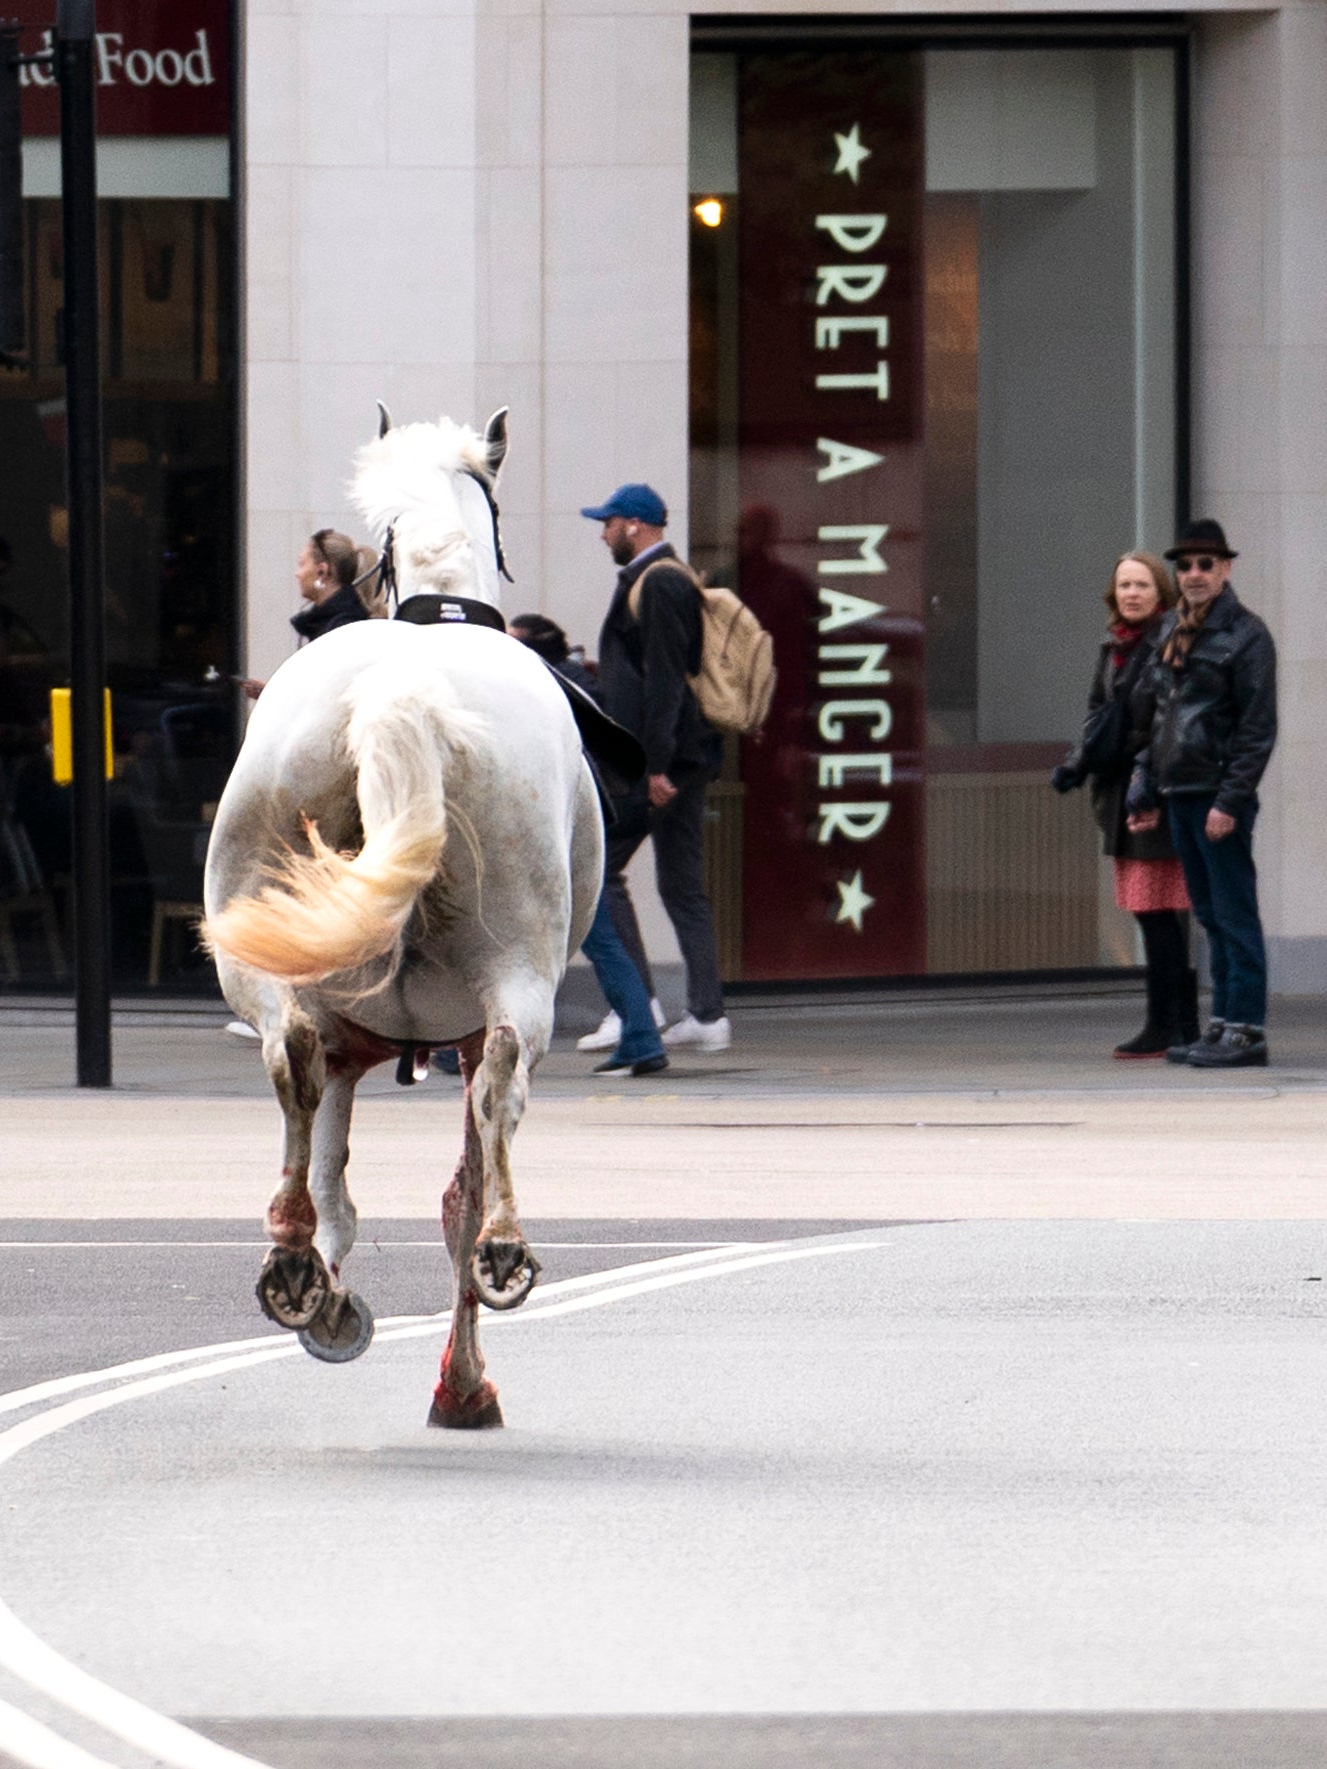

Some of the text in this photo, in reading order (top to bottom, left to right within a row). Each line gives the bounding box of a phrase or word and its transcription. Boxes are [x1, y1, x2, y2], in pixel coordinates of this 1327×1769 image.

[95, 28, 215, 86] Food
[814, 213, 893, 845] PRET A MANGER
